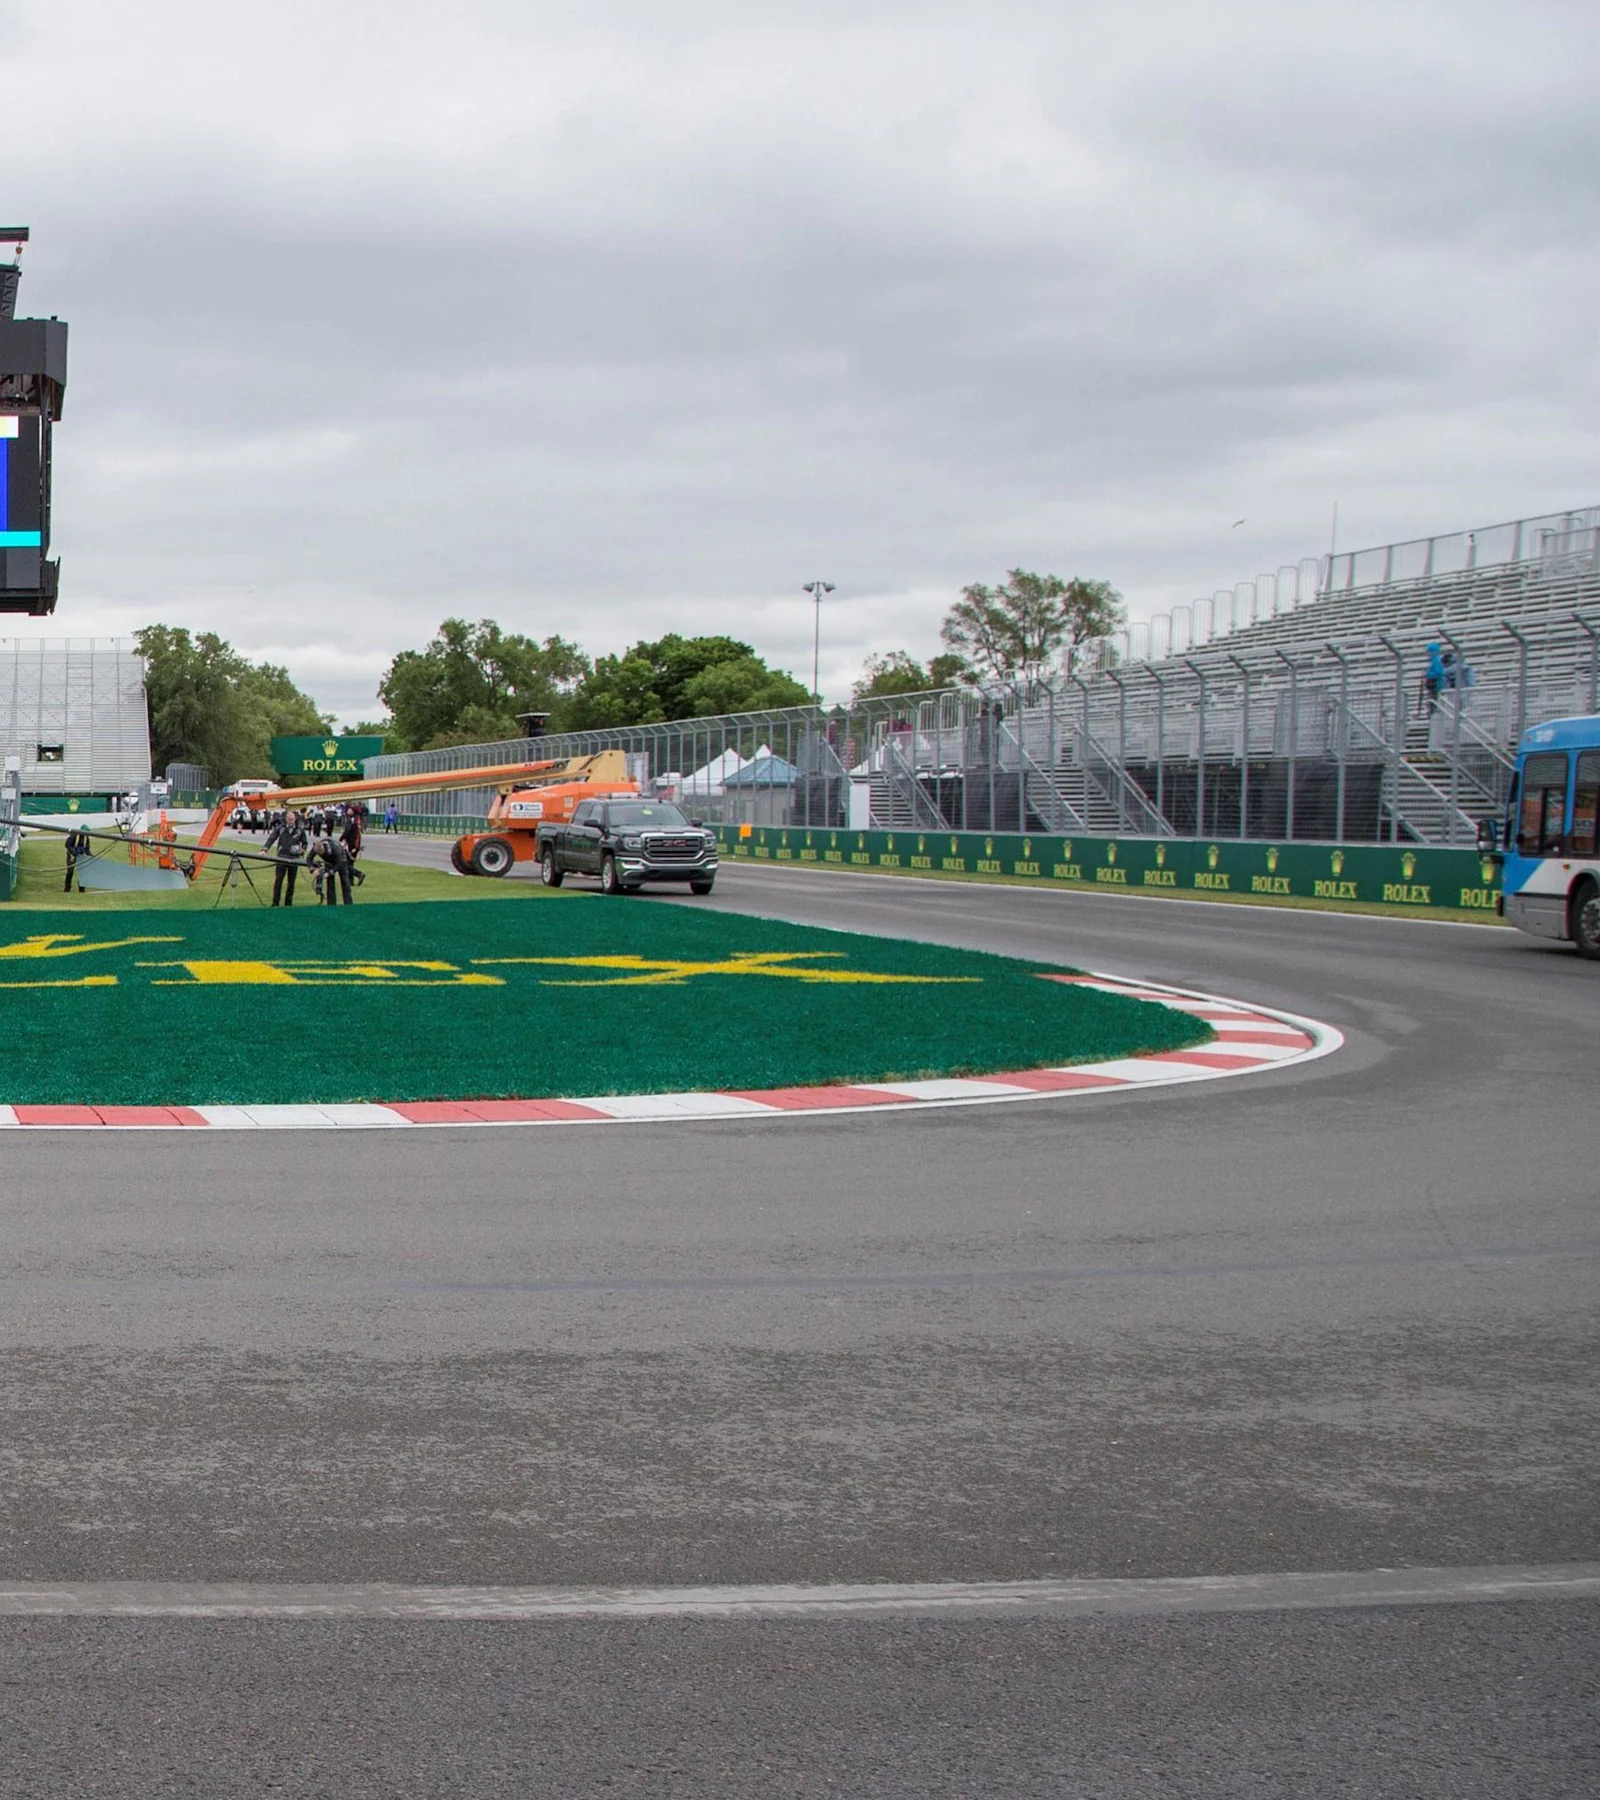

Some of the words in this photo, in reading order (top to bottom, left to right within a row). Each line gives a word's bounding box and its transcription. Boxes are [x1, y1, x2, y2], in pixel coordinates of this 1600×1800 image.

[303, 759, 357, 771] ROLEX
[911, 856, 931, 868] ROLEX
[943, 857, 965, 870] ROLEX
[977, 860, 1001, 873] ROLEX
[1014, 862, 1039, 875] ROLEX
[1053, 864, 1082, 879] ROLEX
[1096, 867, 1127, 883] ROLEX
[1143, 870, 1176, 887] ROLEX
[1194, 873, 1230, 890] ROLEX
[1251, 876, 1291, 895] ROLEX
[1314, 881, 1357, 900] ROLEX
[1383, 884, 1431, 904] ROLEX
[1460, 888, 1501, 908] ROLE
